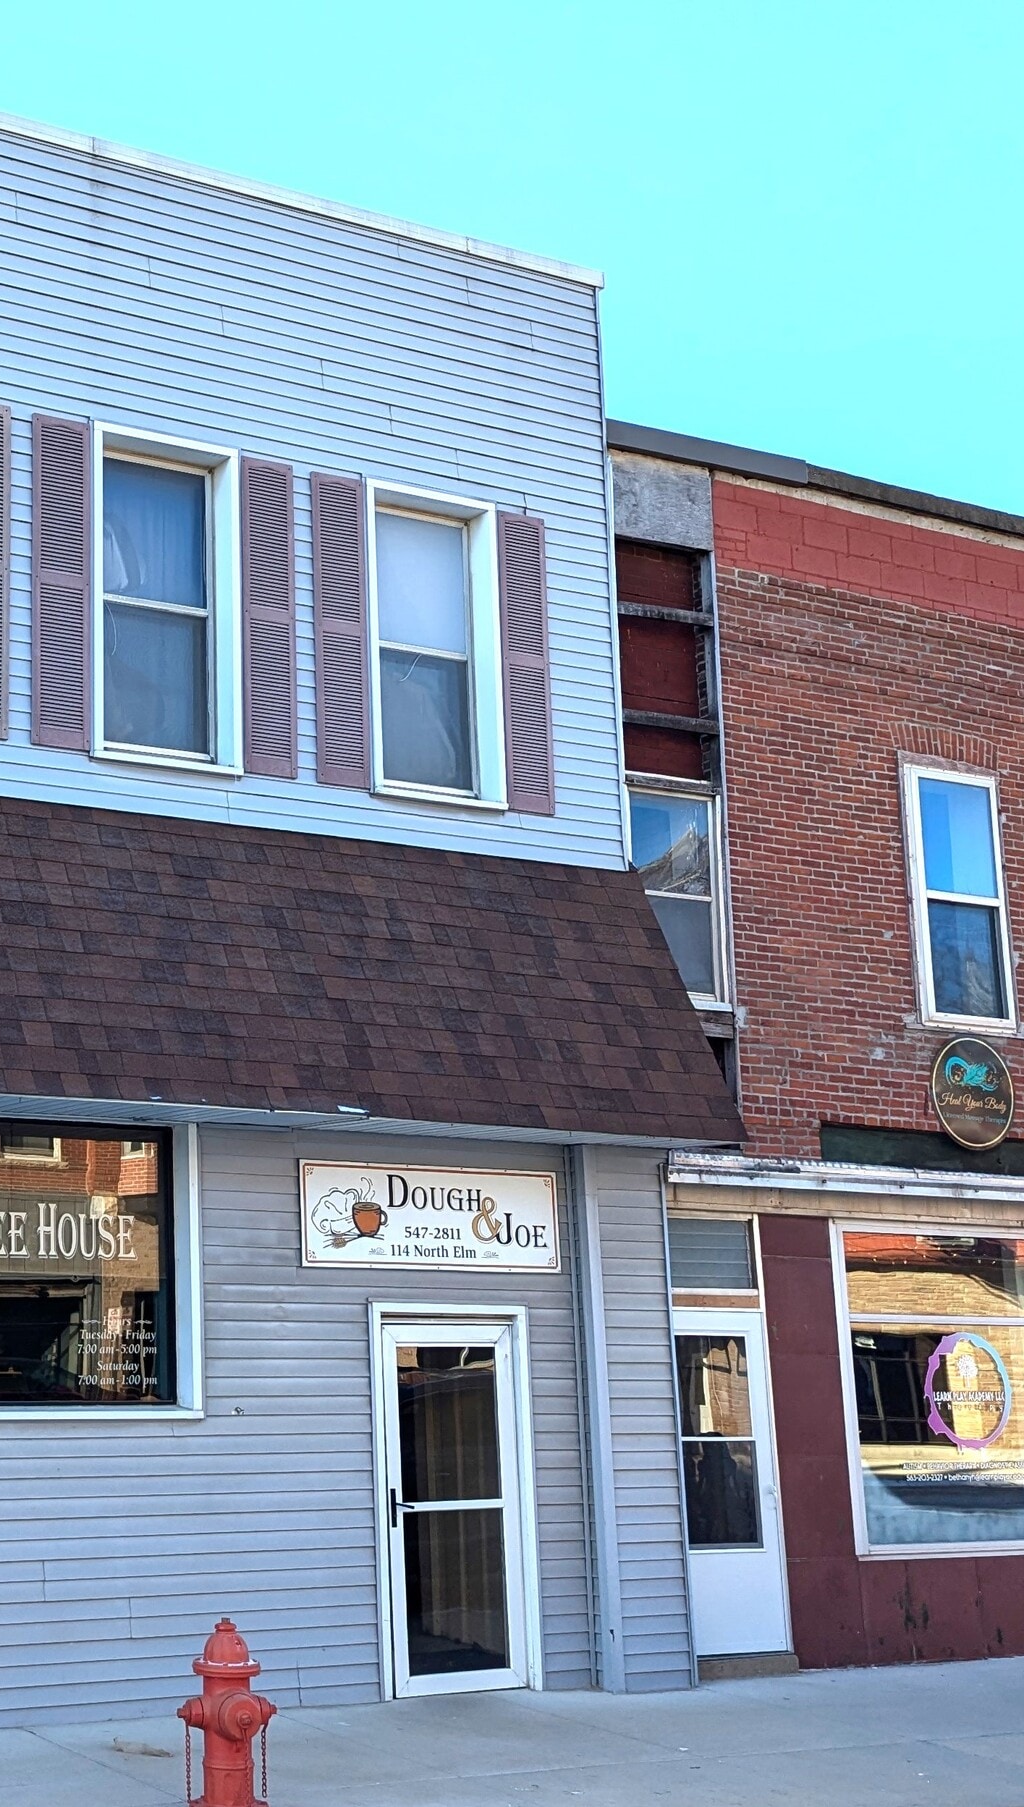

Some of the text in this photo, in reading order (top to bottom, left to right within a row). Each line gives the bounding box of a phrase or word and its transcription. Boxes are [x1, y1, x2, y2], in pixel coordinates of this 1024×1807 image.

[962, 1094, 983, 1111] Your
[984, 1097, 1007, 1114] Body
[386, 1174, 548, 1248] DOUGH & JOE
[36, 1202, 139, 1262] HOUSE
[404, 1226, 462, 1241] 547-2811
[391, 1244, 477, 1260] 114 North Elm
[80, 1329, 117, 1341] Tuesday
[125, 1329, 156, 1342] Friday
[77, 1343, 97, 1354] 7:00
[143, 1346, 157, 1357] pm
[96, 1360, 140, 1373] Saturday
[78, 1375, 98, 1385] 7:00
[143, 1377, 157, 1388] pm
[933, 1391, 1005, 1402] LEARN PLAY ACADEMY LLC
